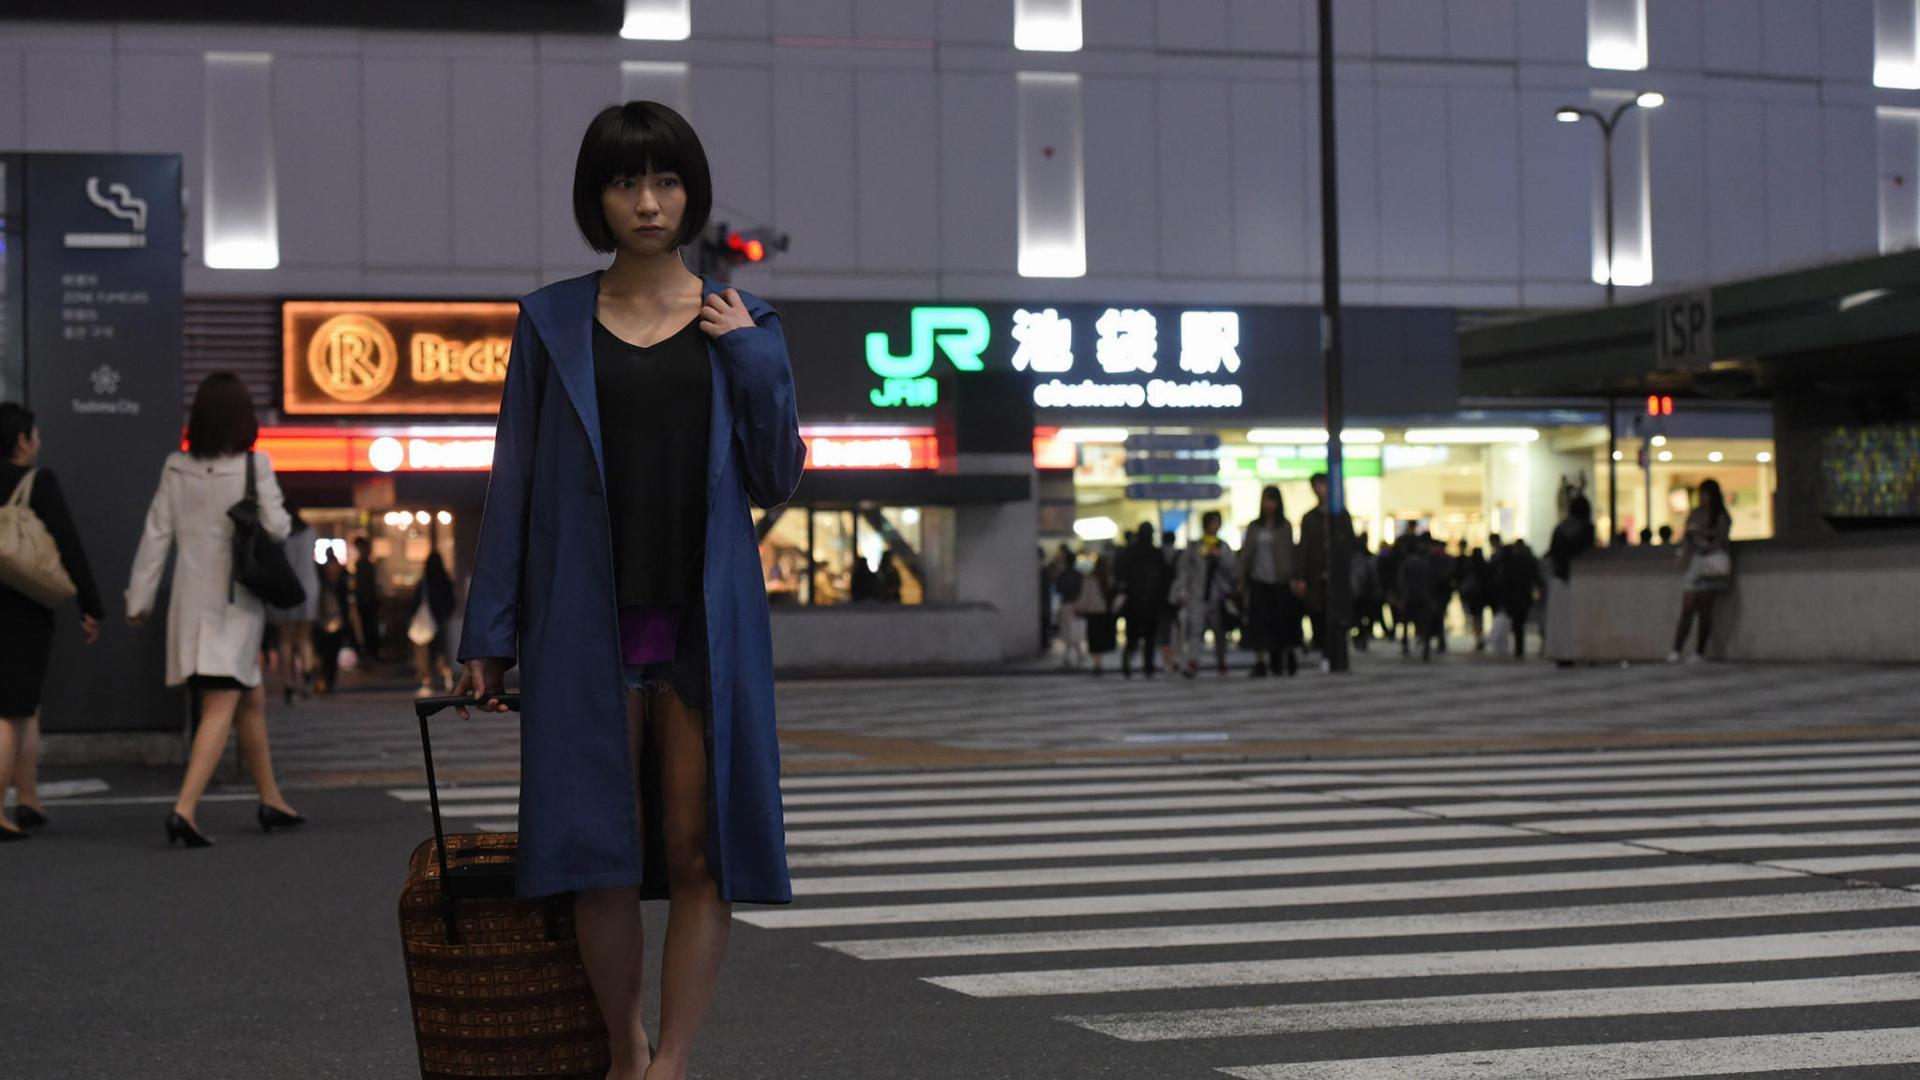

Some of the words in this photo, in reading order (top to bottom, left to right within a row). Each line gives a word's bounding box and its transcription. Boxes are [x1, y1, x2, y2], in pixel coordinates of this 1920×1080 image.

[866, 307, 990, 377] JR
[1011, 308, 1241, 374] 池袋駅
